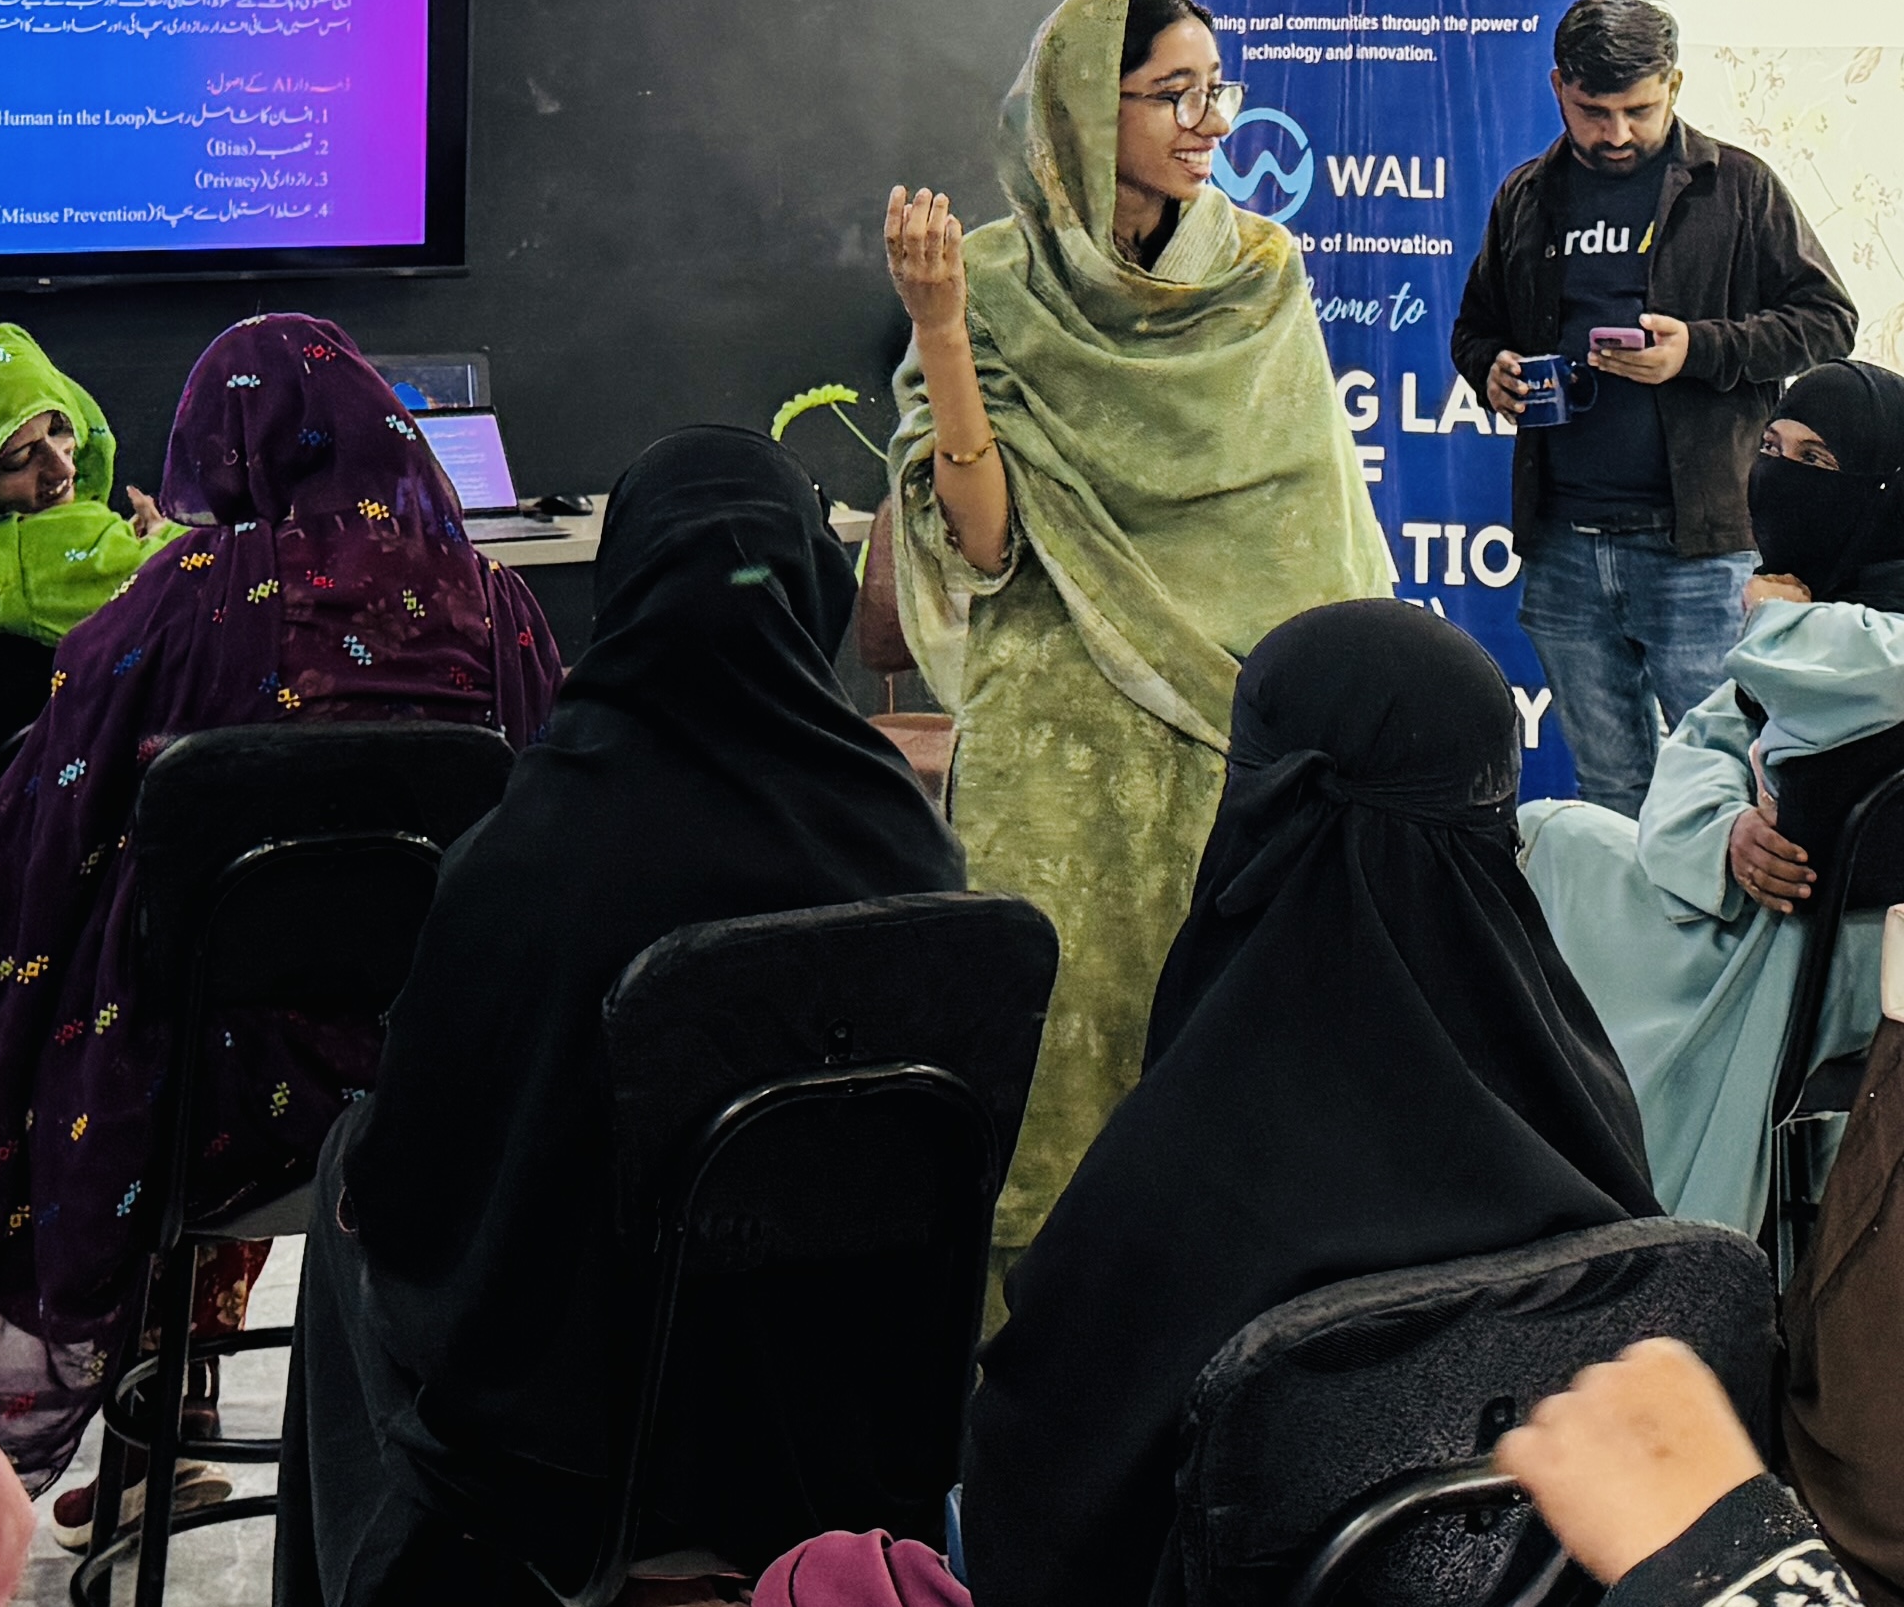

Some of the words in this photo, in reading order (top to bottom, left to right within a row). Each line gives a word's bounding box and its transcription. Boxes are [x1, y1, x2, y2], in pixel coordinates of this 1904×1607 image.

[1212, 15, 1246, 34] ming
[1250, 14, 1283, 30] rural
[1286, 14, 1379, 31] communities
[1382, 14, 1440, 35] through
[1444, 15, 1468, 31] the
[1471, 17, 1519, 35] power
[1522, 15, 1539, 32] of
[1242, 43, 1323, 63] technology
[1325, 44, 1353, 61] and
[1356, 44, 1438, 62] innovation.
[57, 109, 73, 126] in
[76, 109, 101, 126] the
[206, 137, 256, 158] (Bias)
[194, 168, 267, 193] (Privacy)
[1326, 155, 1446, 199] WALI
[63, 202, 155, 224] Prevention)
[1295, 233, 1316, 253] ab
[1320, 233, 1342, 253] of
[1347, 233, 1453, 255] Innovation
[1564, 220, 1630, 255] rdu
[1306, 275, 1383, 326] come
[1388, 282, 1428, 332] to
[1356, 446, 1386, 483] F
